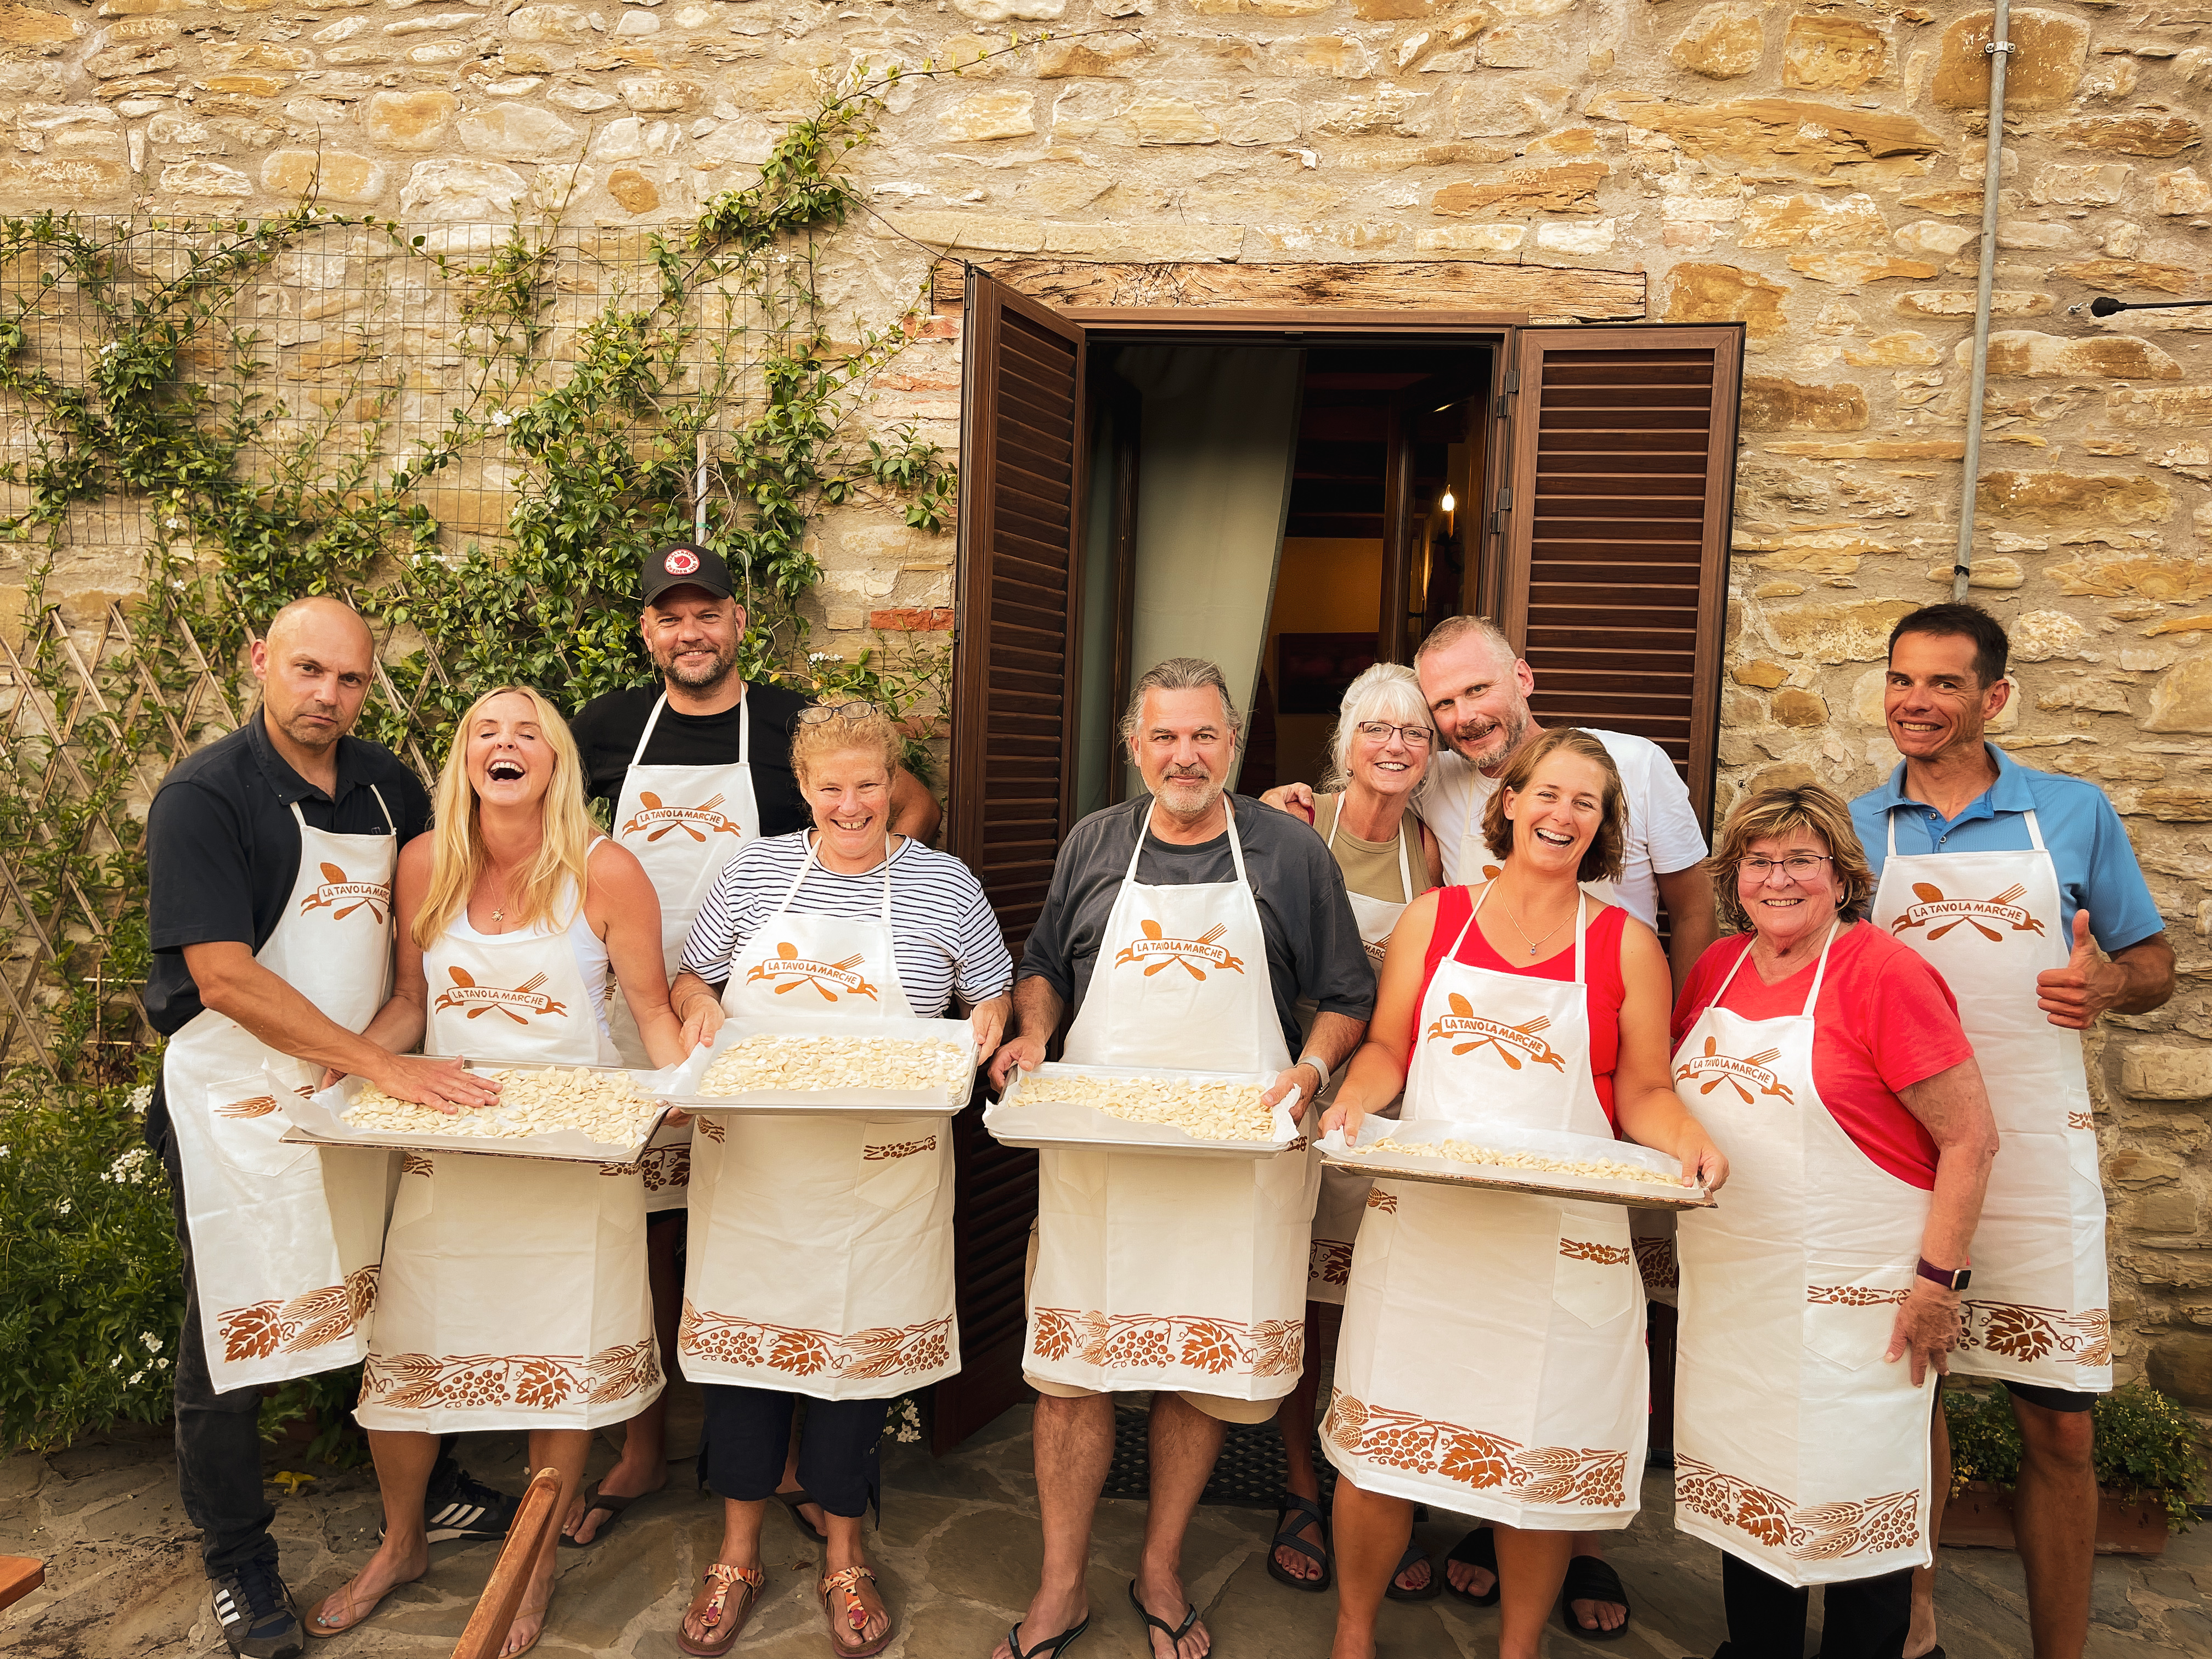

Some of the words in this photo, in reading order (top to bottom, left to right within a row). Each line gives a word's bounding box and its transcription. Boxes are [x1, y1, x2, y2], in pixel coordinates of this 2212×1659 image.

[640, 814, 650, 822] LA
[651, 810, 683, 819] TAVOLA
[685, 811, 721, 823] MARCHE
[323, 888, 334, 897] LA
[334, 885, 371, 895] TAVOLA
[373, 888, 389, 900] MARC
[1914, 907, 1928, 917] LA
[1928, 903, 1971, 913] TAVOLA
[1974, 903, 2022, 920] MARCHE
[1137, 944, 1149, 952] LA
[1183, 944, 1223, 959] MARCHE
[1364, 944, 1385, 958] MARC
[769, 962, 780, 970] LA
[781, 962, 816, 972] TAVOLA
[818, 967, 857, 984] MARCHE
[464, 990, 499, 998] TAVOLA
[501, 992, 544, 1005] MARCHE
[1445, 1019, 1457, 1029] LA
[1457, 1019, 1497, 1034] TAVOLA
[1498, 1028, 1543, 1052] MARCHE
[1705, 1058, 1730, 1069] TAVOLA
[1731, 1062, 1771, 1084] MARCHE
